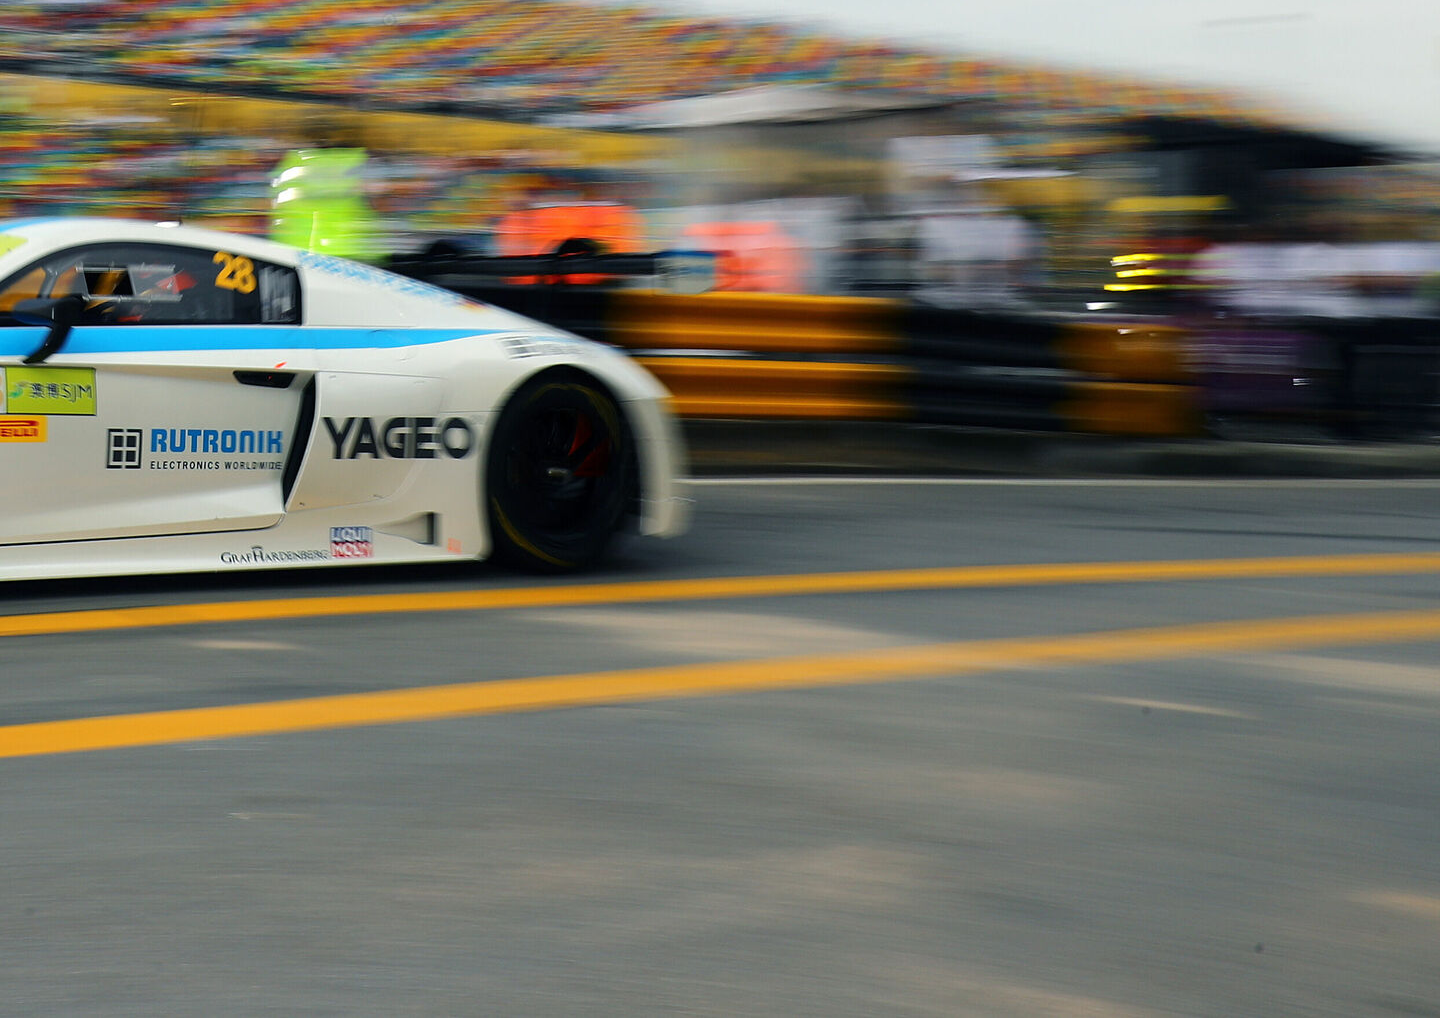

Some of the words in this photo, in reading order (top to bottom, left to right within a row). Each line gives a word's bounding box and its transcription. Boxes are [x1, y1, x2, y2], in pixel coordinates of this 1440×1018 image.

[212, 251, 257, 294] 28
[60, 383, 93, 402] SJM
[151, 428, 283, 454] RUTRONIK
[321, 416, 475, 460] YAGEO
[150, 460, 220, 470] ELECTRONICS
[224, 461, 283, 470] WORLDWIDE
